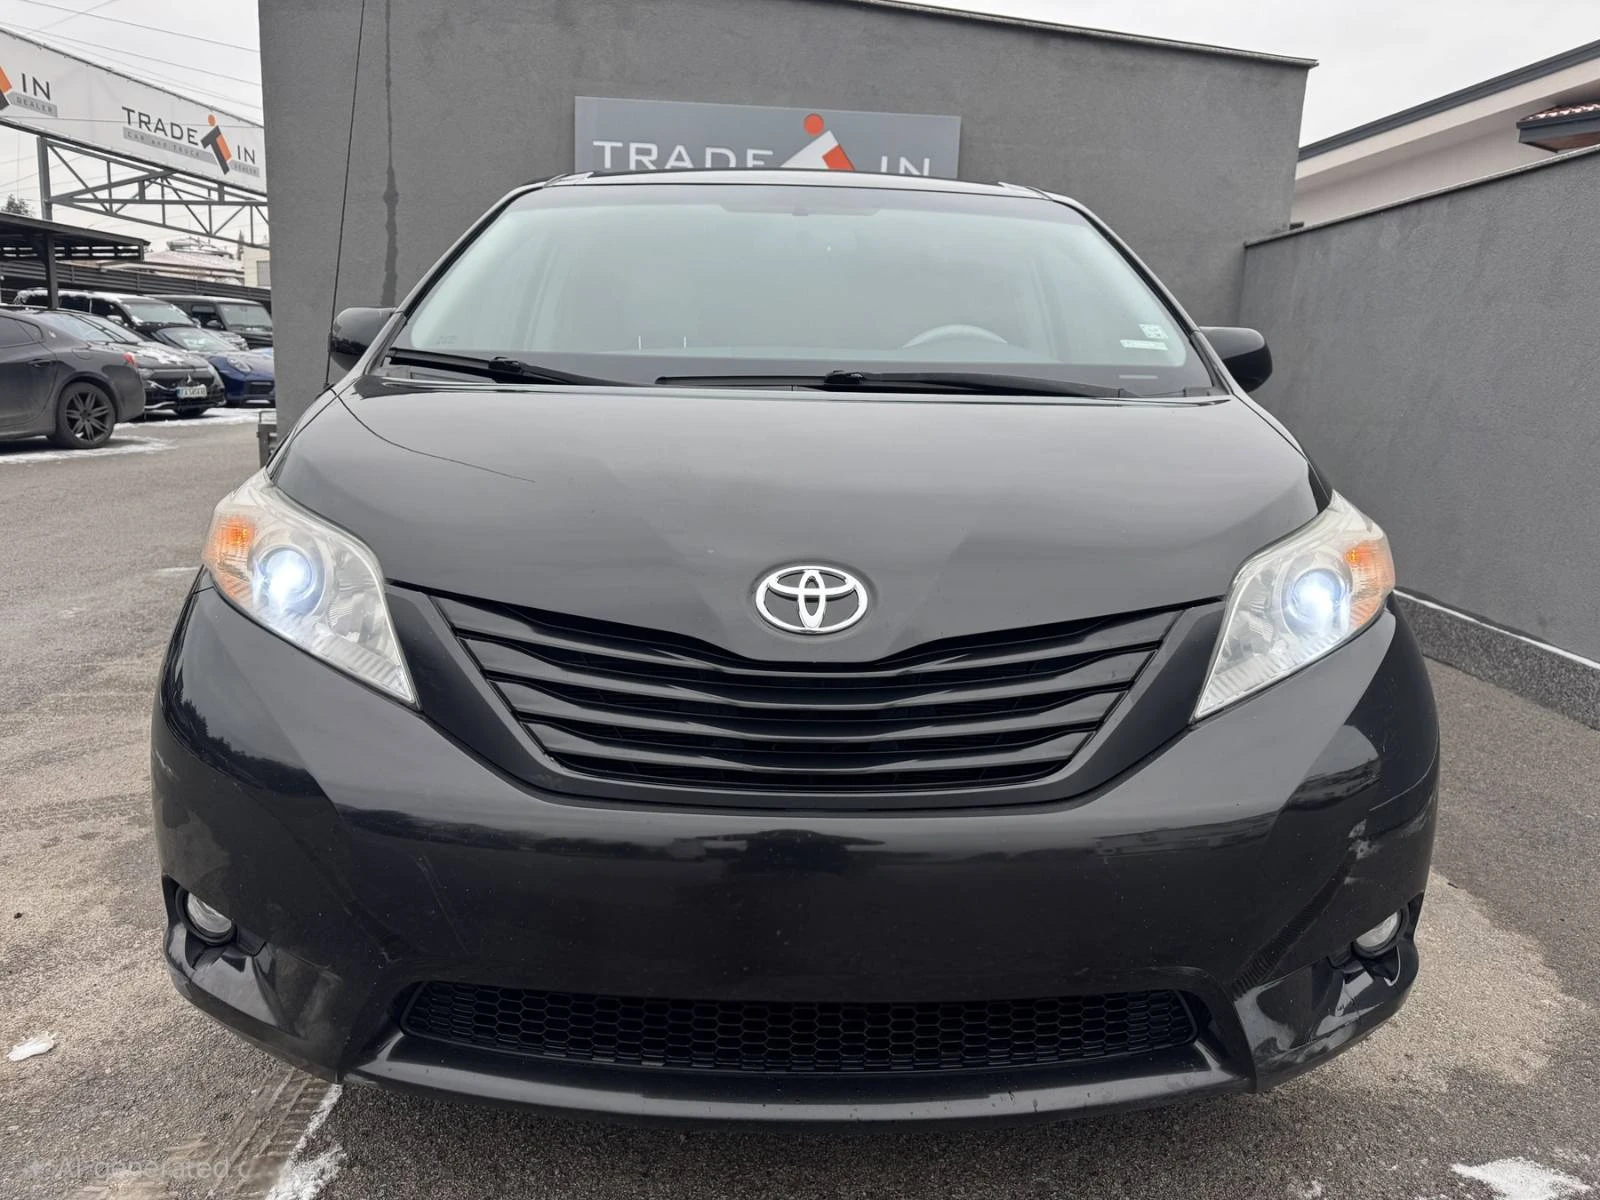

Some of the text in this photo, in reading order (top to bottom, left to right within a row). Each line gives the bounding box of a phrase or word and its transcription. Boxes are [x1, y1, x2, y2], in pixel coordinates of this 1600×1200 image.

[22, 72, 51, 101] IN
[122, 105, 256, 165] TRADE IN
[593, 140, 931, 177] TRADE IN
